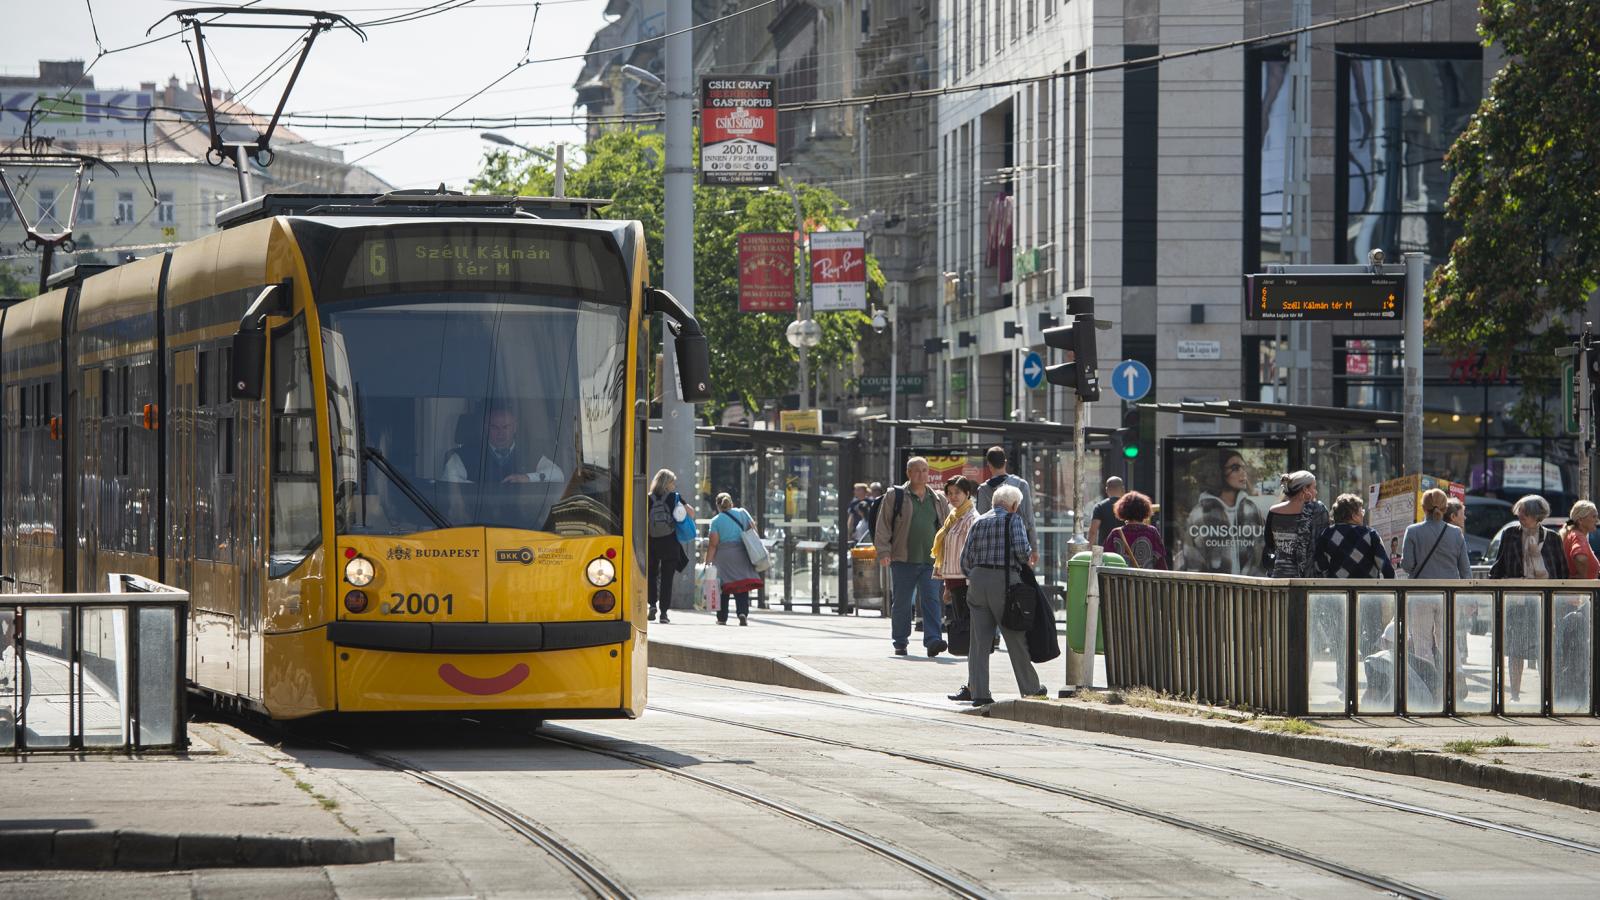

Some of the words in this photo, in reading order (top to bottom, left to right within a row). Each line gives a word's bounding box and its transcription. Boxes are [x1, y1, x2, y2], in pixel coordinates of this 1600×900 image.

[708, 80, 736, 89] CSÍKI
[738, 81, 772, 89] CRAFT
[712, 99, 772, 107] GASTROPUB
[722, 145, 743, 154] 200
[746, 145, 758, 154] M
[415, 245, 469, 259] Széll
[477, 245, 550, 260] Kálmán
[369, 244, 386, 276] 6
[456, 261, 488, 275] tér
[496, 263, 510, 275] M
[813, 251, 862, 279] Ray-Ban
[1282, 301, 1301, 309] Széll
[1303, 301, 1329, 309] Kálmán
[1331, 301, 1343, 309] tér
[1189, 525, 1265, 537] CONSCIOU
[1205, 539, 1255, 547] COLLECTION
[415, 549, 480, 558] BUDAPEST
[499, 552, 518, 560] BKK
[389, 593, 454, 615] 2001
